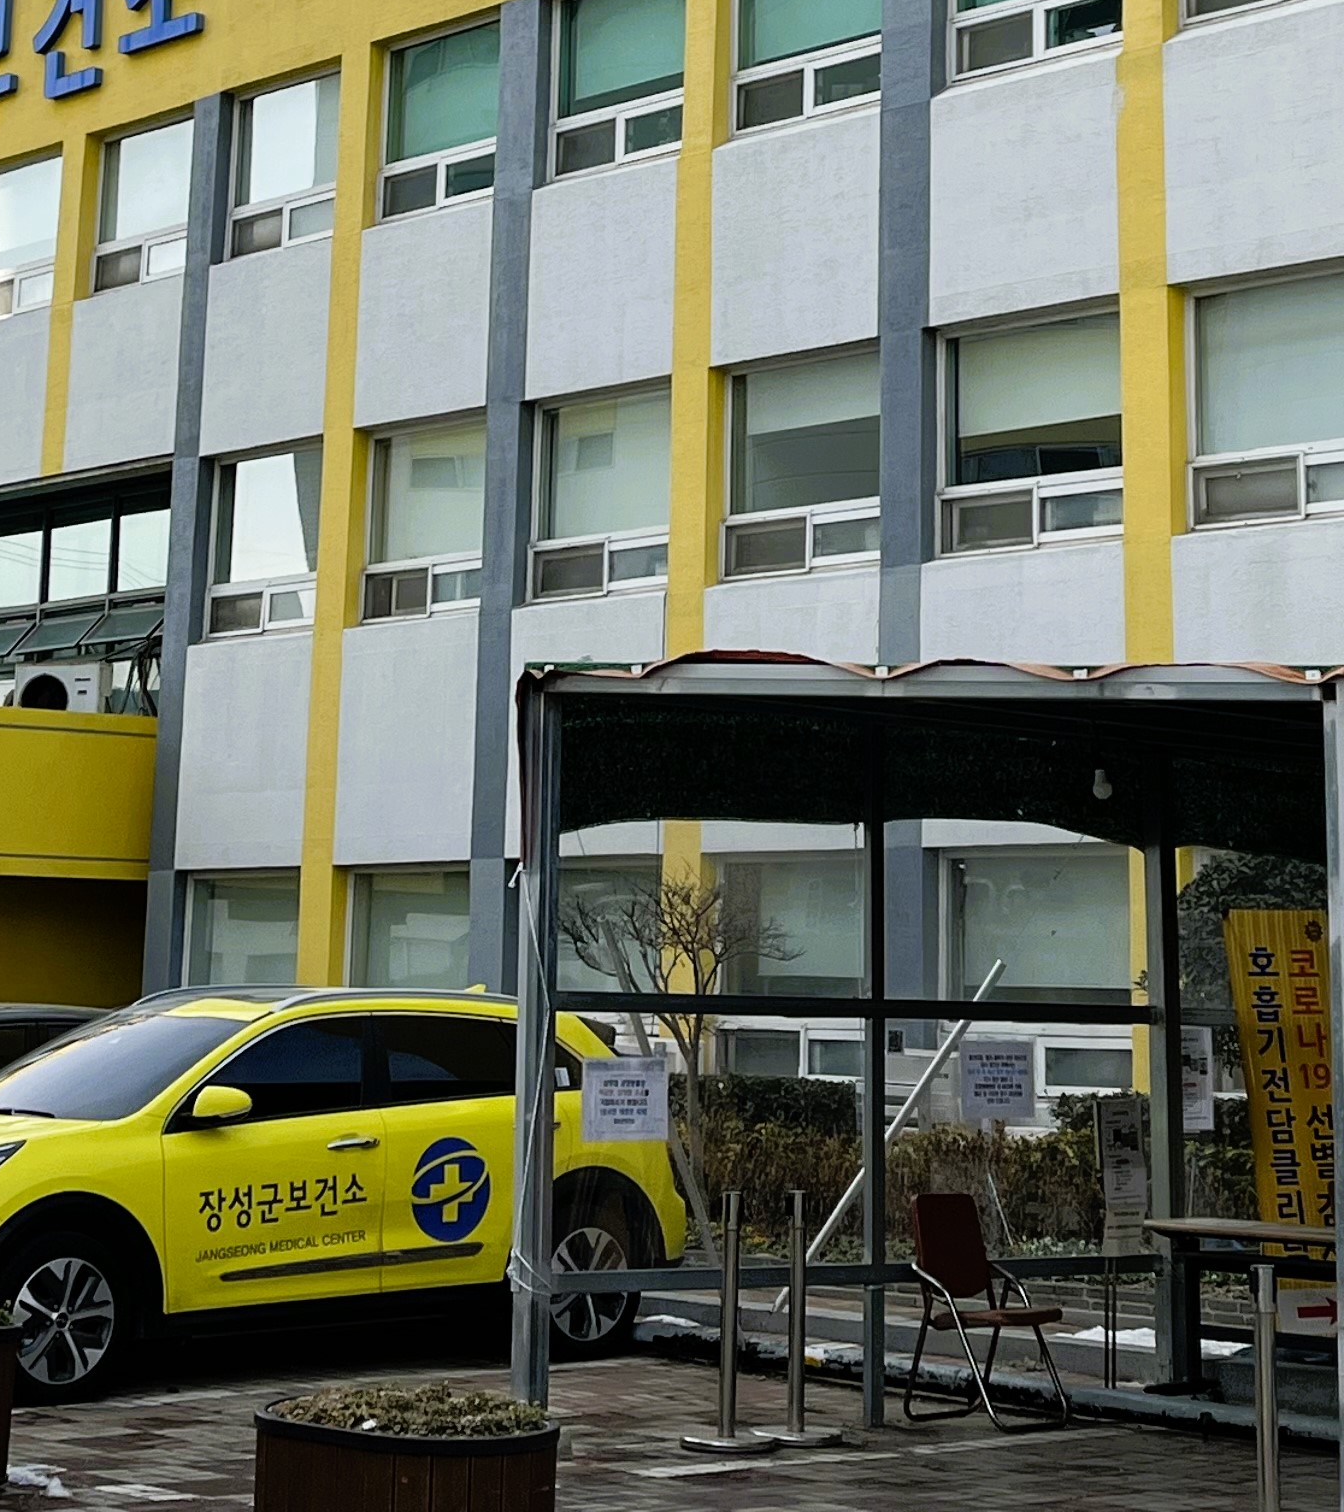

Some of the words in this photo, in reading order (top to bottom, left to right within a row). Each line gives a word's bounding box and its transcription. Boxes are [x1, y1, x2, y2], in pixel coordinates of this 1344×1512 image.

[1247, 946, 1308, 1254] 호흡기전담클리
[198, 1173, 368, 1233] 장성군보건소
[195, 1241, 267, 1263] JANGSEONG
[269, 1237, 319, 1254] MEDICAL
[322, 1229, 367, 1247] CENTER
